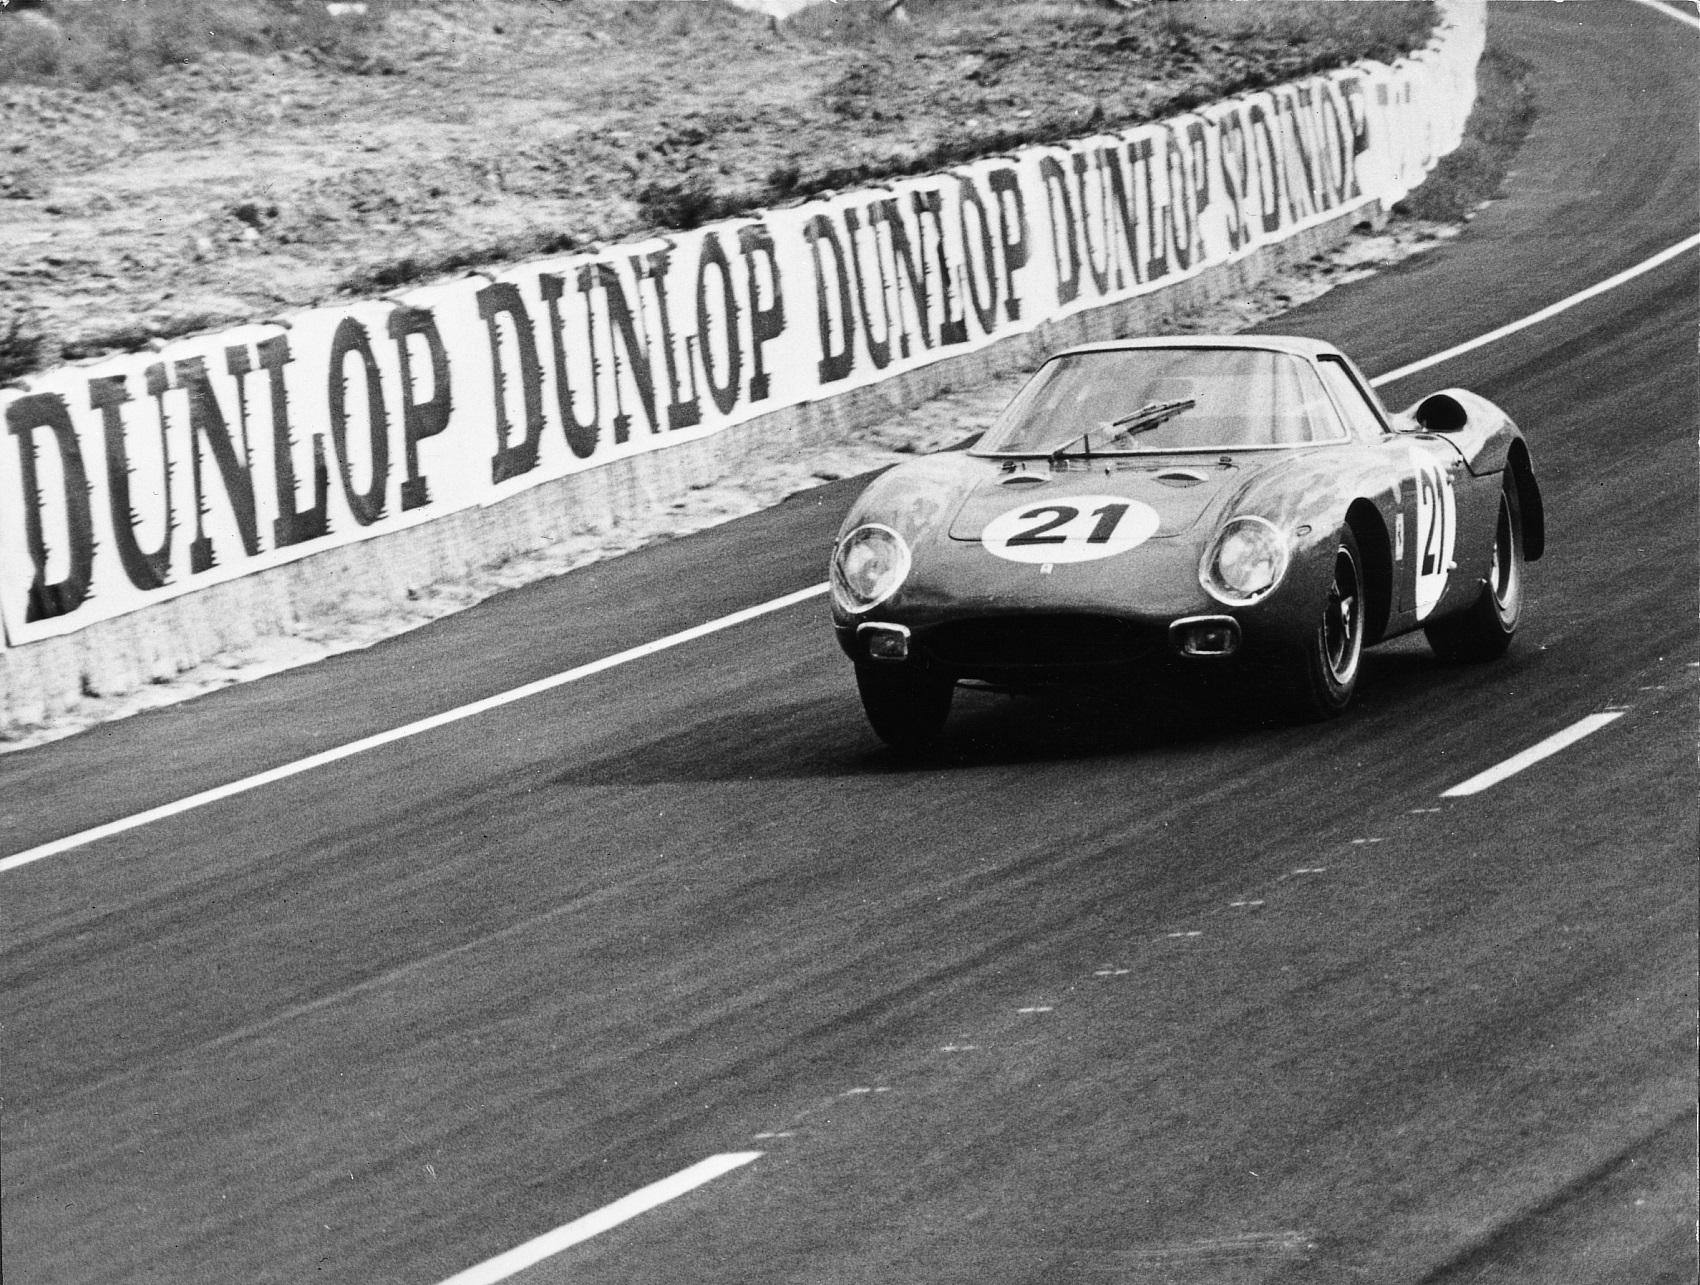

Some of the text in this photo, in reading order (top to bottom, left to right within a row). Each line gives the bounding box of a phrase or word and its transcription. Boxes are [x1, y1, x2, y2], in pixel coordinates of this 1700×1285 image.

[5, 306, 454, 624] DUNLOP
[476, 223, 788, 485] DUNLOP
[803, 167, 1031, 385] DUNLOP
[1040, 121, 1210, 306] DUNLOP
[1005, 503, 1131, 548] 21
[1420, 466, 1446, 577] 21
